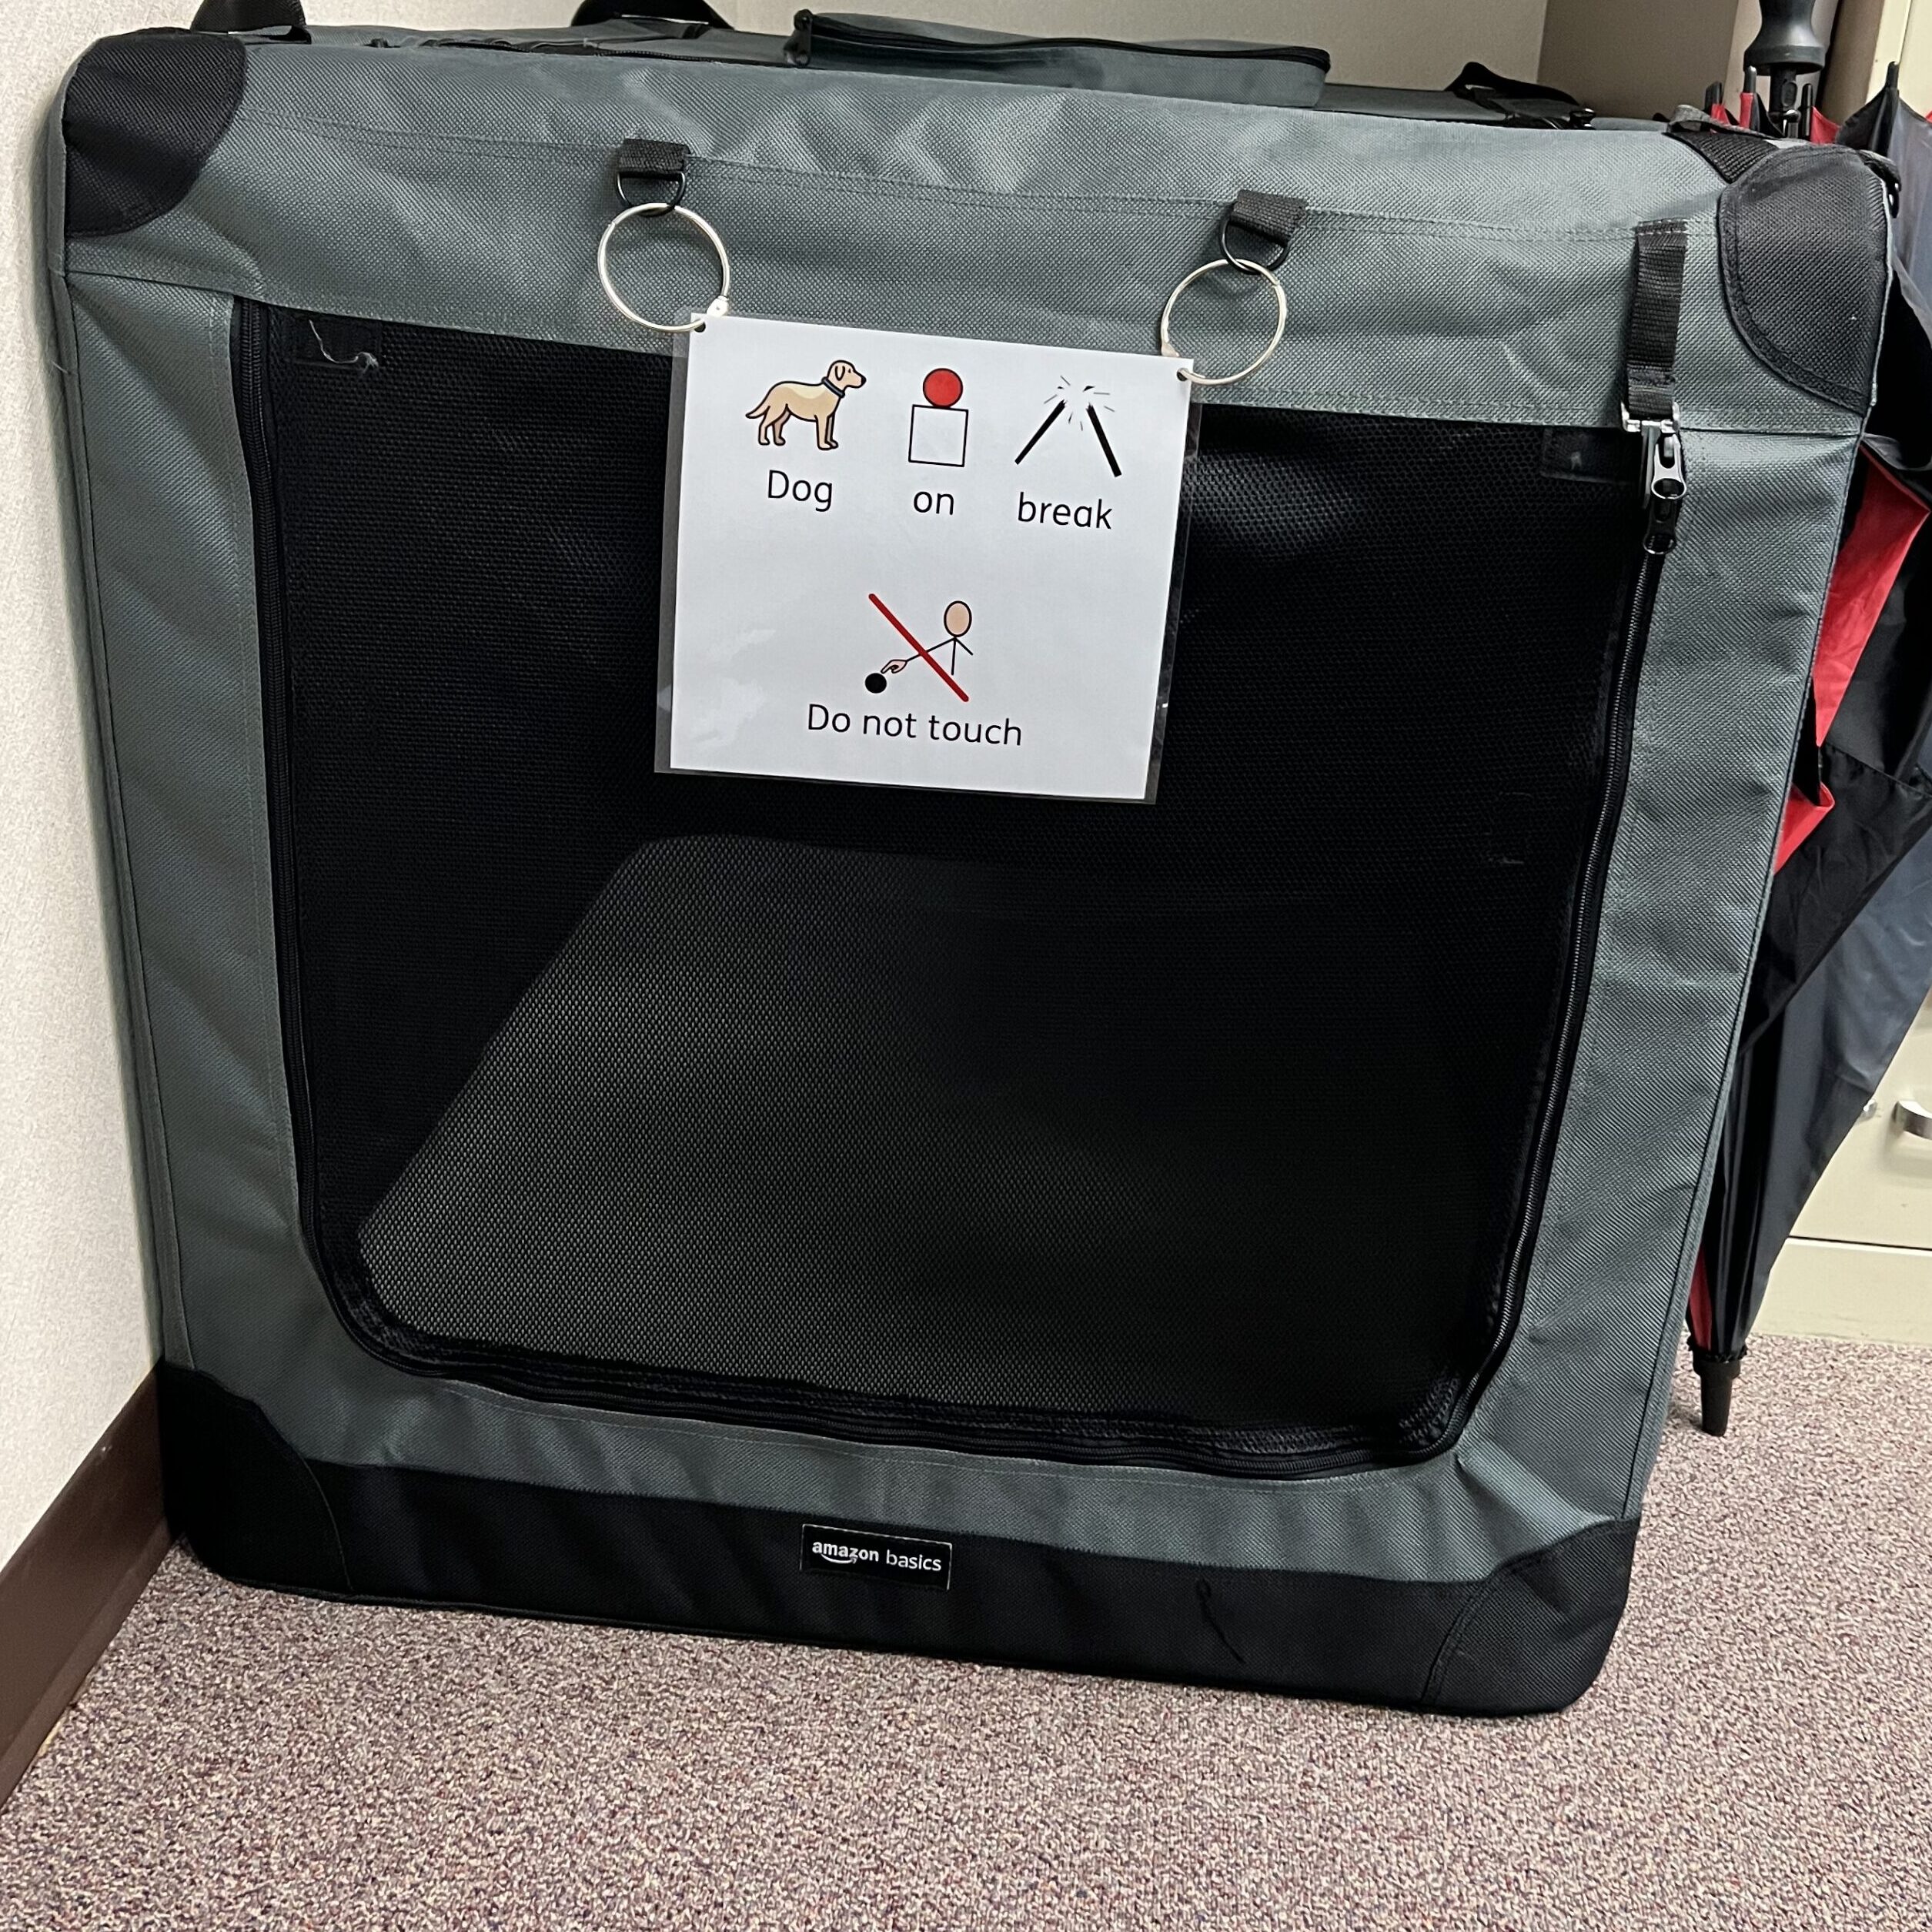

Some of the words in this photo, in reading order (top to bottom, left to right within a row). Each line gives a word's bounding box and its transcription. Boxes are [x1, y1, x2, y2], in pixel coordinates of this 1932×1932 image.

[768, 470, 832, 512] Dog
[914, 492, 954, 515] on
[1018, 492, 1112, 529] break
[808, 704, 850, 732] Do
[864, 714, 917, 738] not
[929, 715, 1021, 745] touch
[812, 1542, 878, 1563] amazon
[887, 1549, 941, 1571] basics
